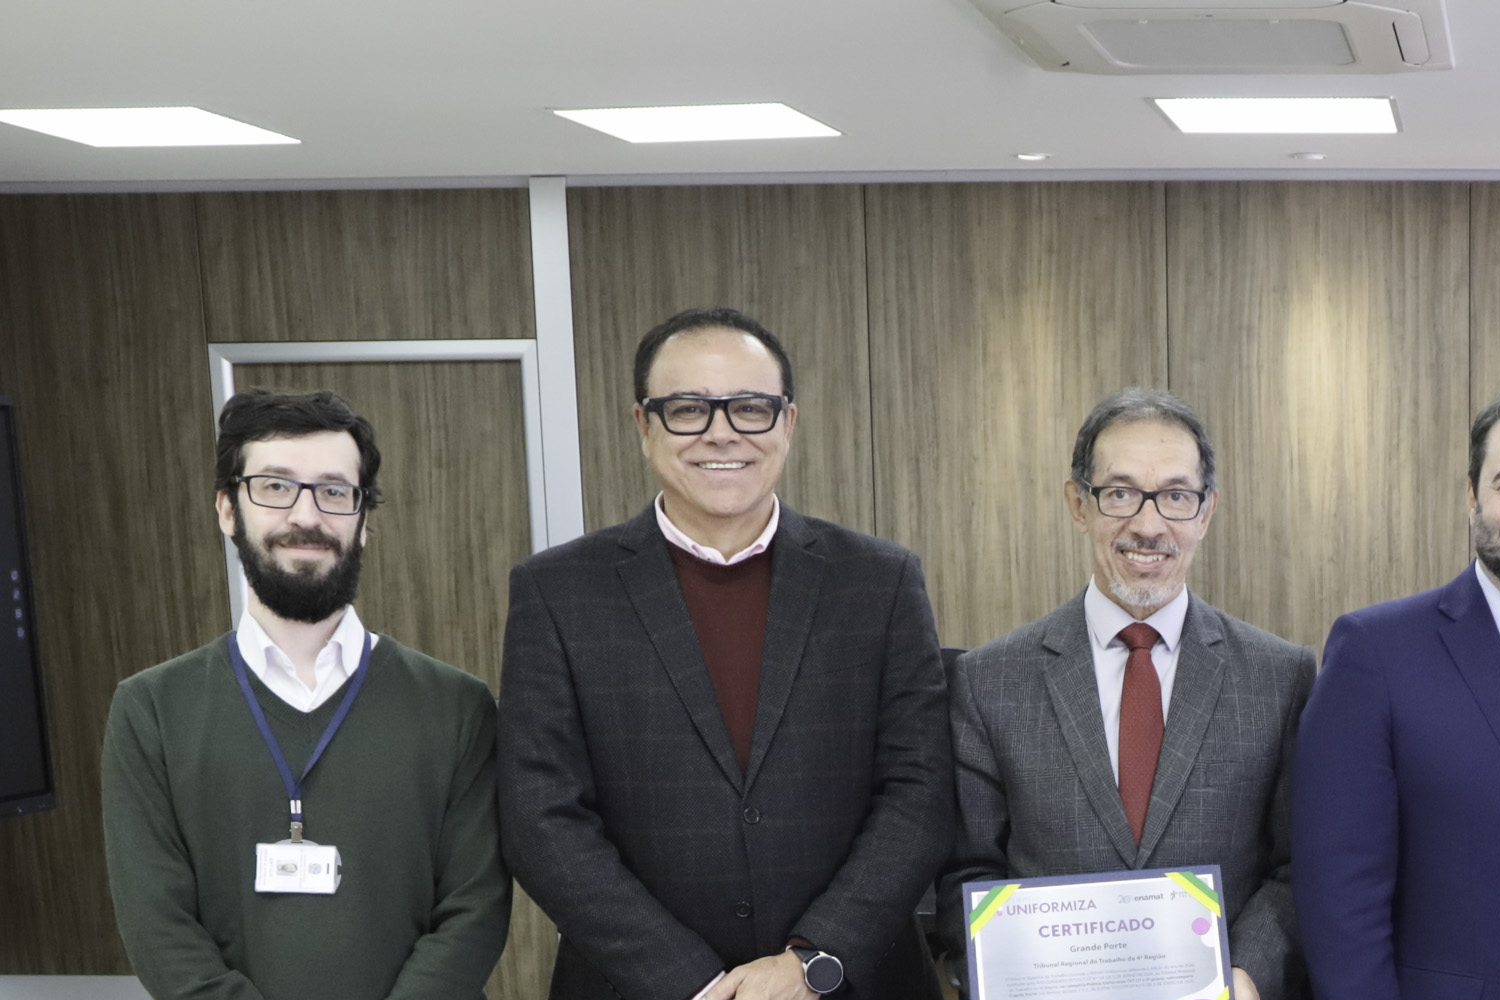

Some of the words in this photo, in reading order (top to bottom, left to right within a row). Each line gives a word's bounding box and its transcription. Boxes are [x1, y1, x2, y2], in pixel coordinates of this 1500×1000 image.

[1134, 893, 1164, 902] enamat
[1006, 899, 1097, 916] UNIFORMIZA
[1038, 917, 1155, 938] CERTIFICADO
[1069, 943, 1102, 953] Grande
[1104, 941, 1127, 951] Porte
[1033, 960, 1059, 969] Tribunal
[1061, 958, 1088, 968] Regional
[1099, 955, 1126, 964] Trabalho
[1144, 953, 1166, 962] Região
